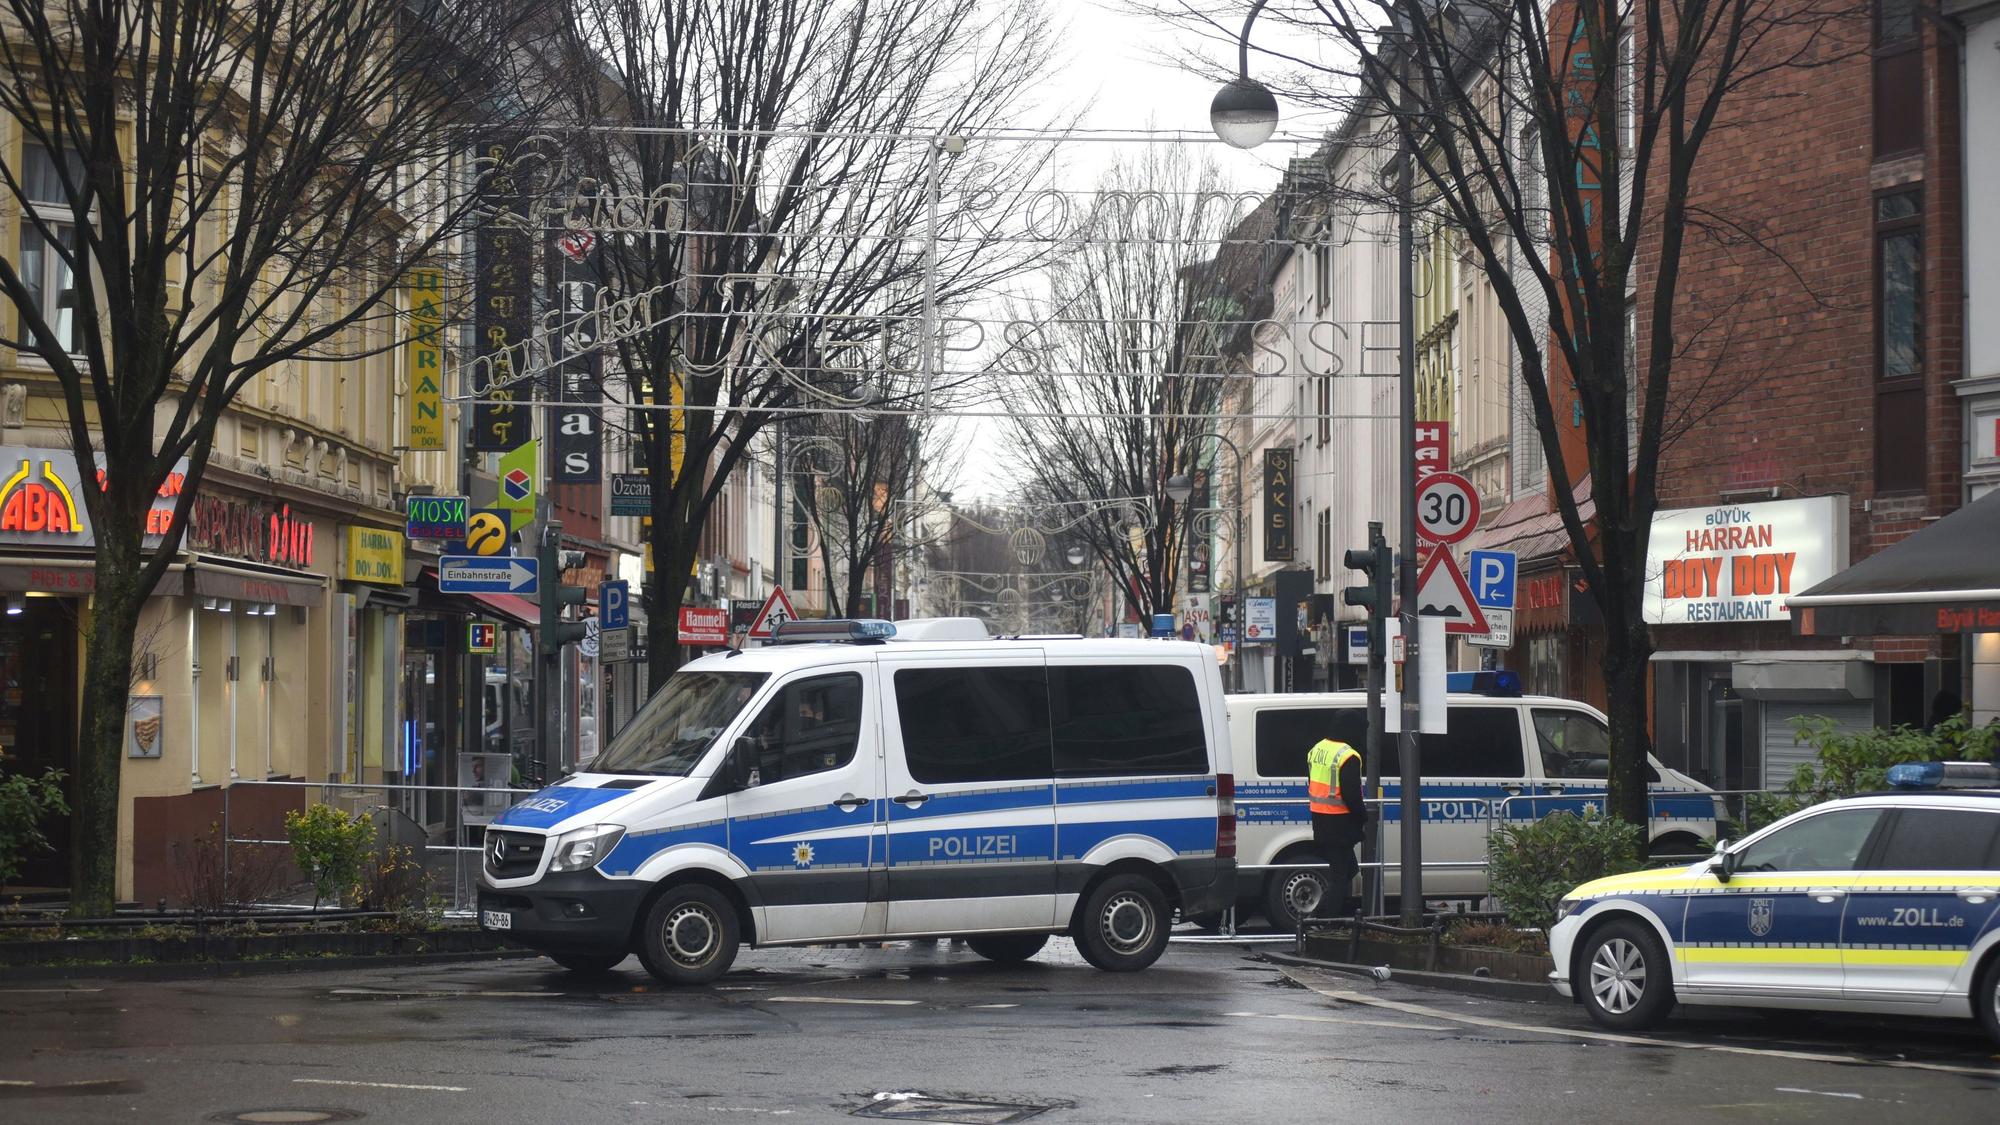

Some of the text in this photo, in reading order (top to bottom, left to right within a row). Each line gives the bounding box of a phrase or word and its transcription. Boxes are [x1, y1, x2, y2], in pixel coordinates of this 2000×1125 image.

[416, 272, 439, 420] HARRAN
[613, 475, 651, 496] Özcan
[410, 501, 464, 522] KIOSK
[1424, 493, 1465, 526] 30
[1705, 507, 1751, 525] BÜYÜK
[361, 532, 392, 550] HARRAN
[1686, 524, 1773, 552] HARRAN
[447, 571, 512, 581] Einbahnstraße
[1479, 558, 1505, 600] P
[1662, 552, 1796, 599] DOY DOY
[607, 588, 622, 624] P
[1185, 610, 1209, 622] ASYA
[1687, 600, 1772, 621] RESTAURANT
[1427, 802, 1511, 819] POLIZEI
[929, 835, 1017, 857] POLIZEI
[1753, 899, 1769, 908] ZOLL
[1857, 908, 1965, 927] www.ZOLL.de
